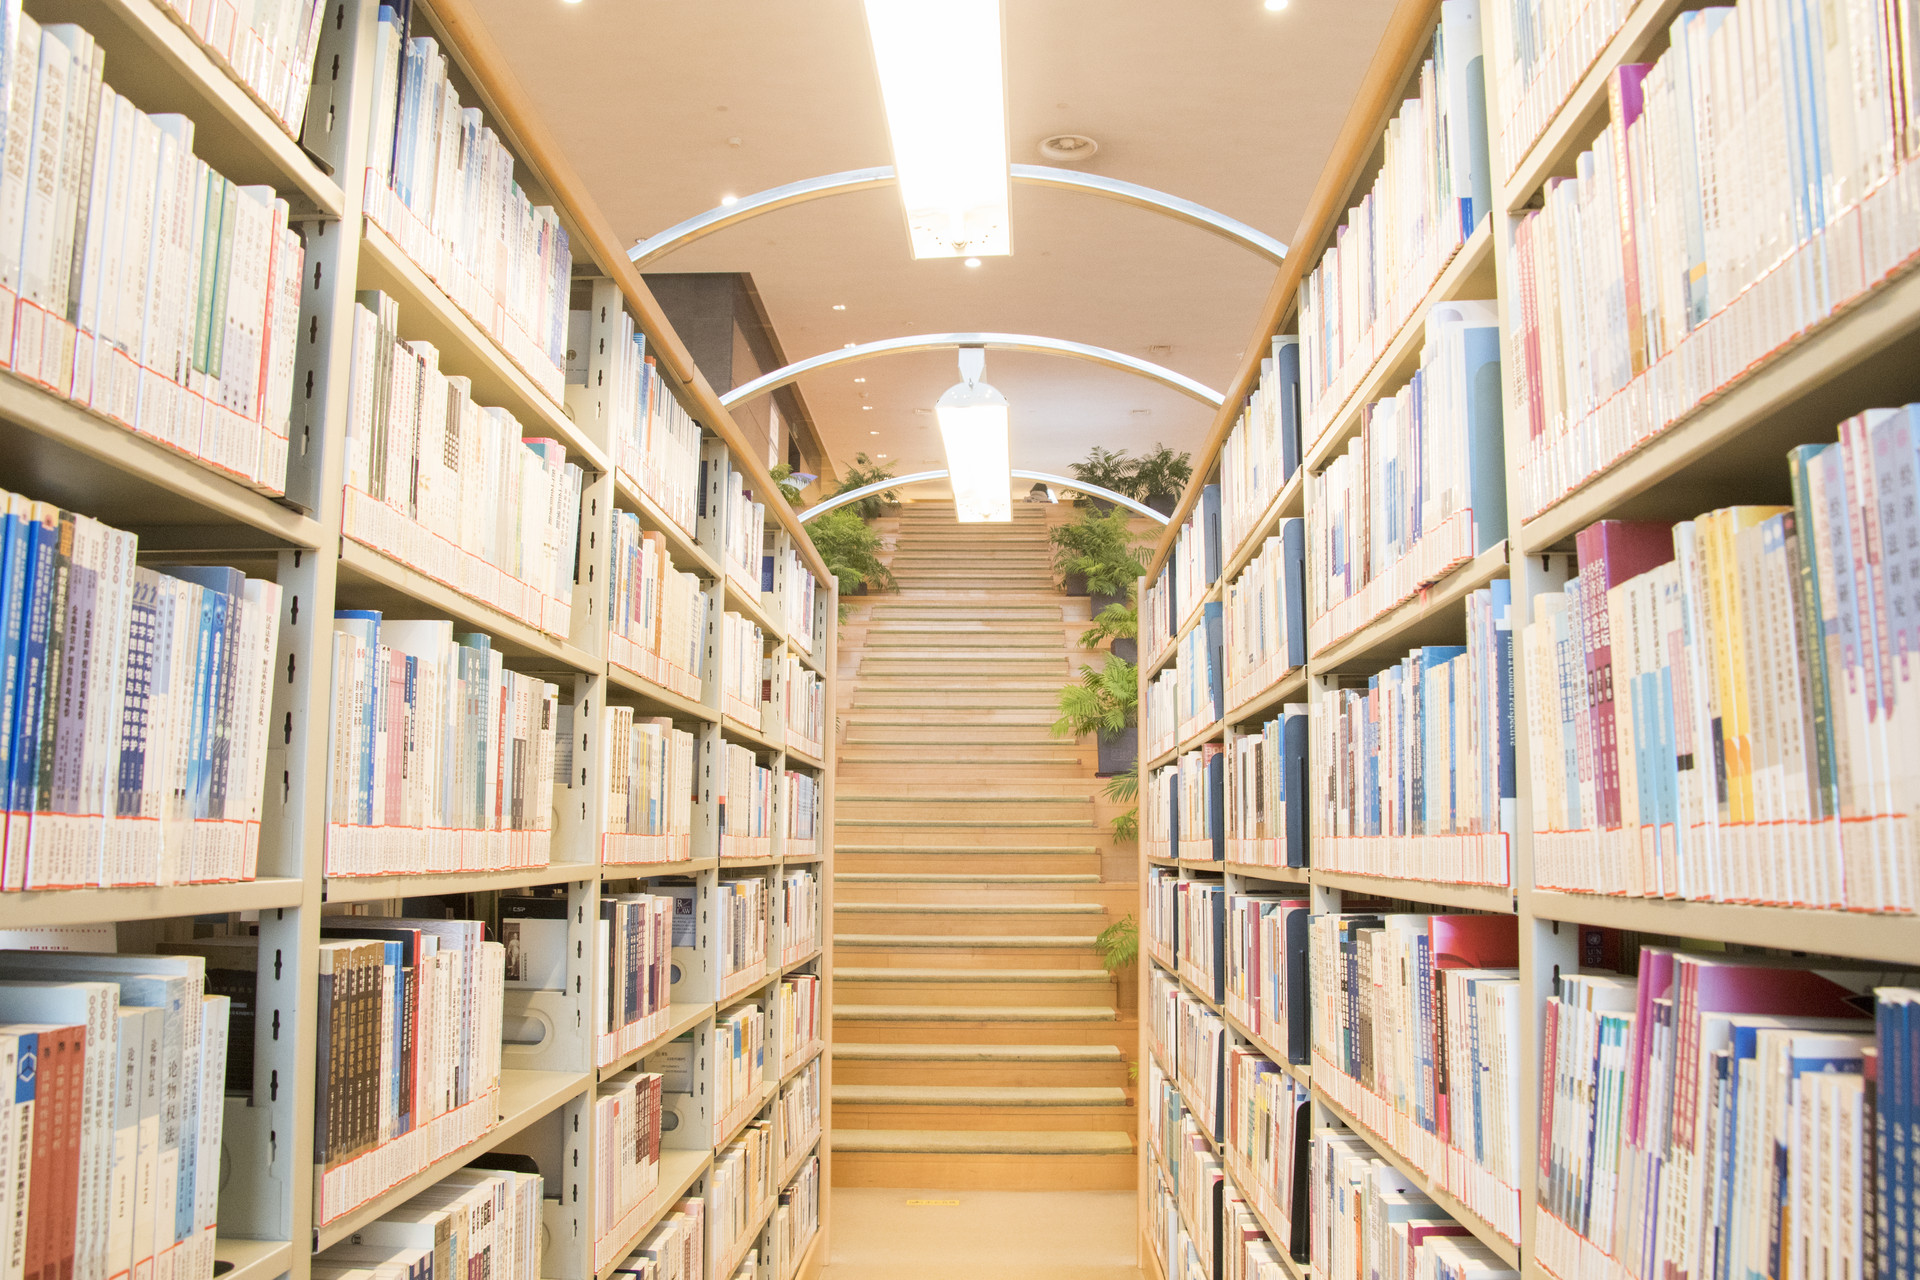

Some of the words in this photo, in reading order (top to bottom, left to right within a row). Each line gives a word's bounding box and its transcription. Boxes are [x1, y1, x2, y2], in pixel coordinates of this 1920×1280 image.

[1594, 558, 1611, 647] 经济法论坛
[121, 608, 139, 752] 数字图书馆与版权保护
[130, 609, 147, 752] 数字图书馆与版权保护
[138, 612, 155, 753] 数字图书馆与版权保护
[125, 1047, 135, 1108] 论物权法
[148, 1039, 158, 1098] 论物权法
[164, 1061, 178, 1145] 论物权法
